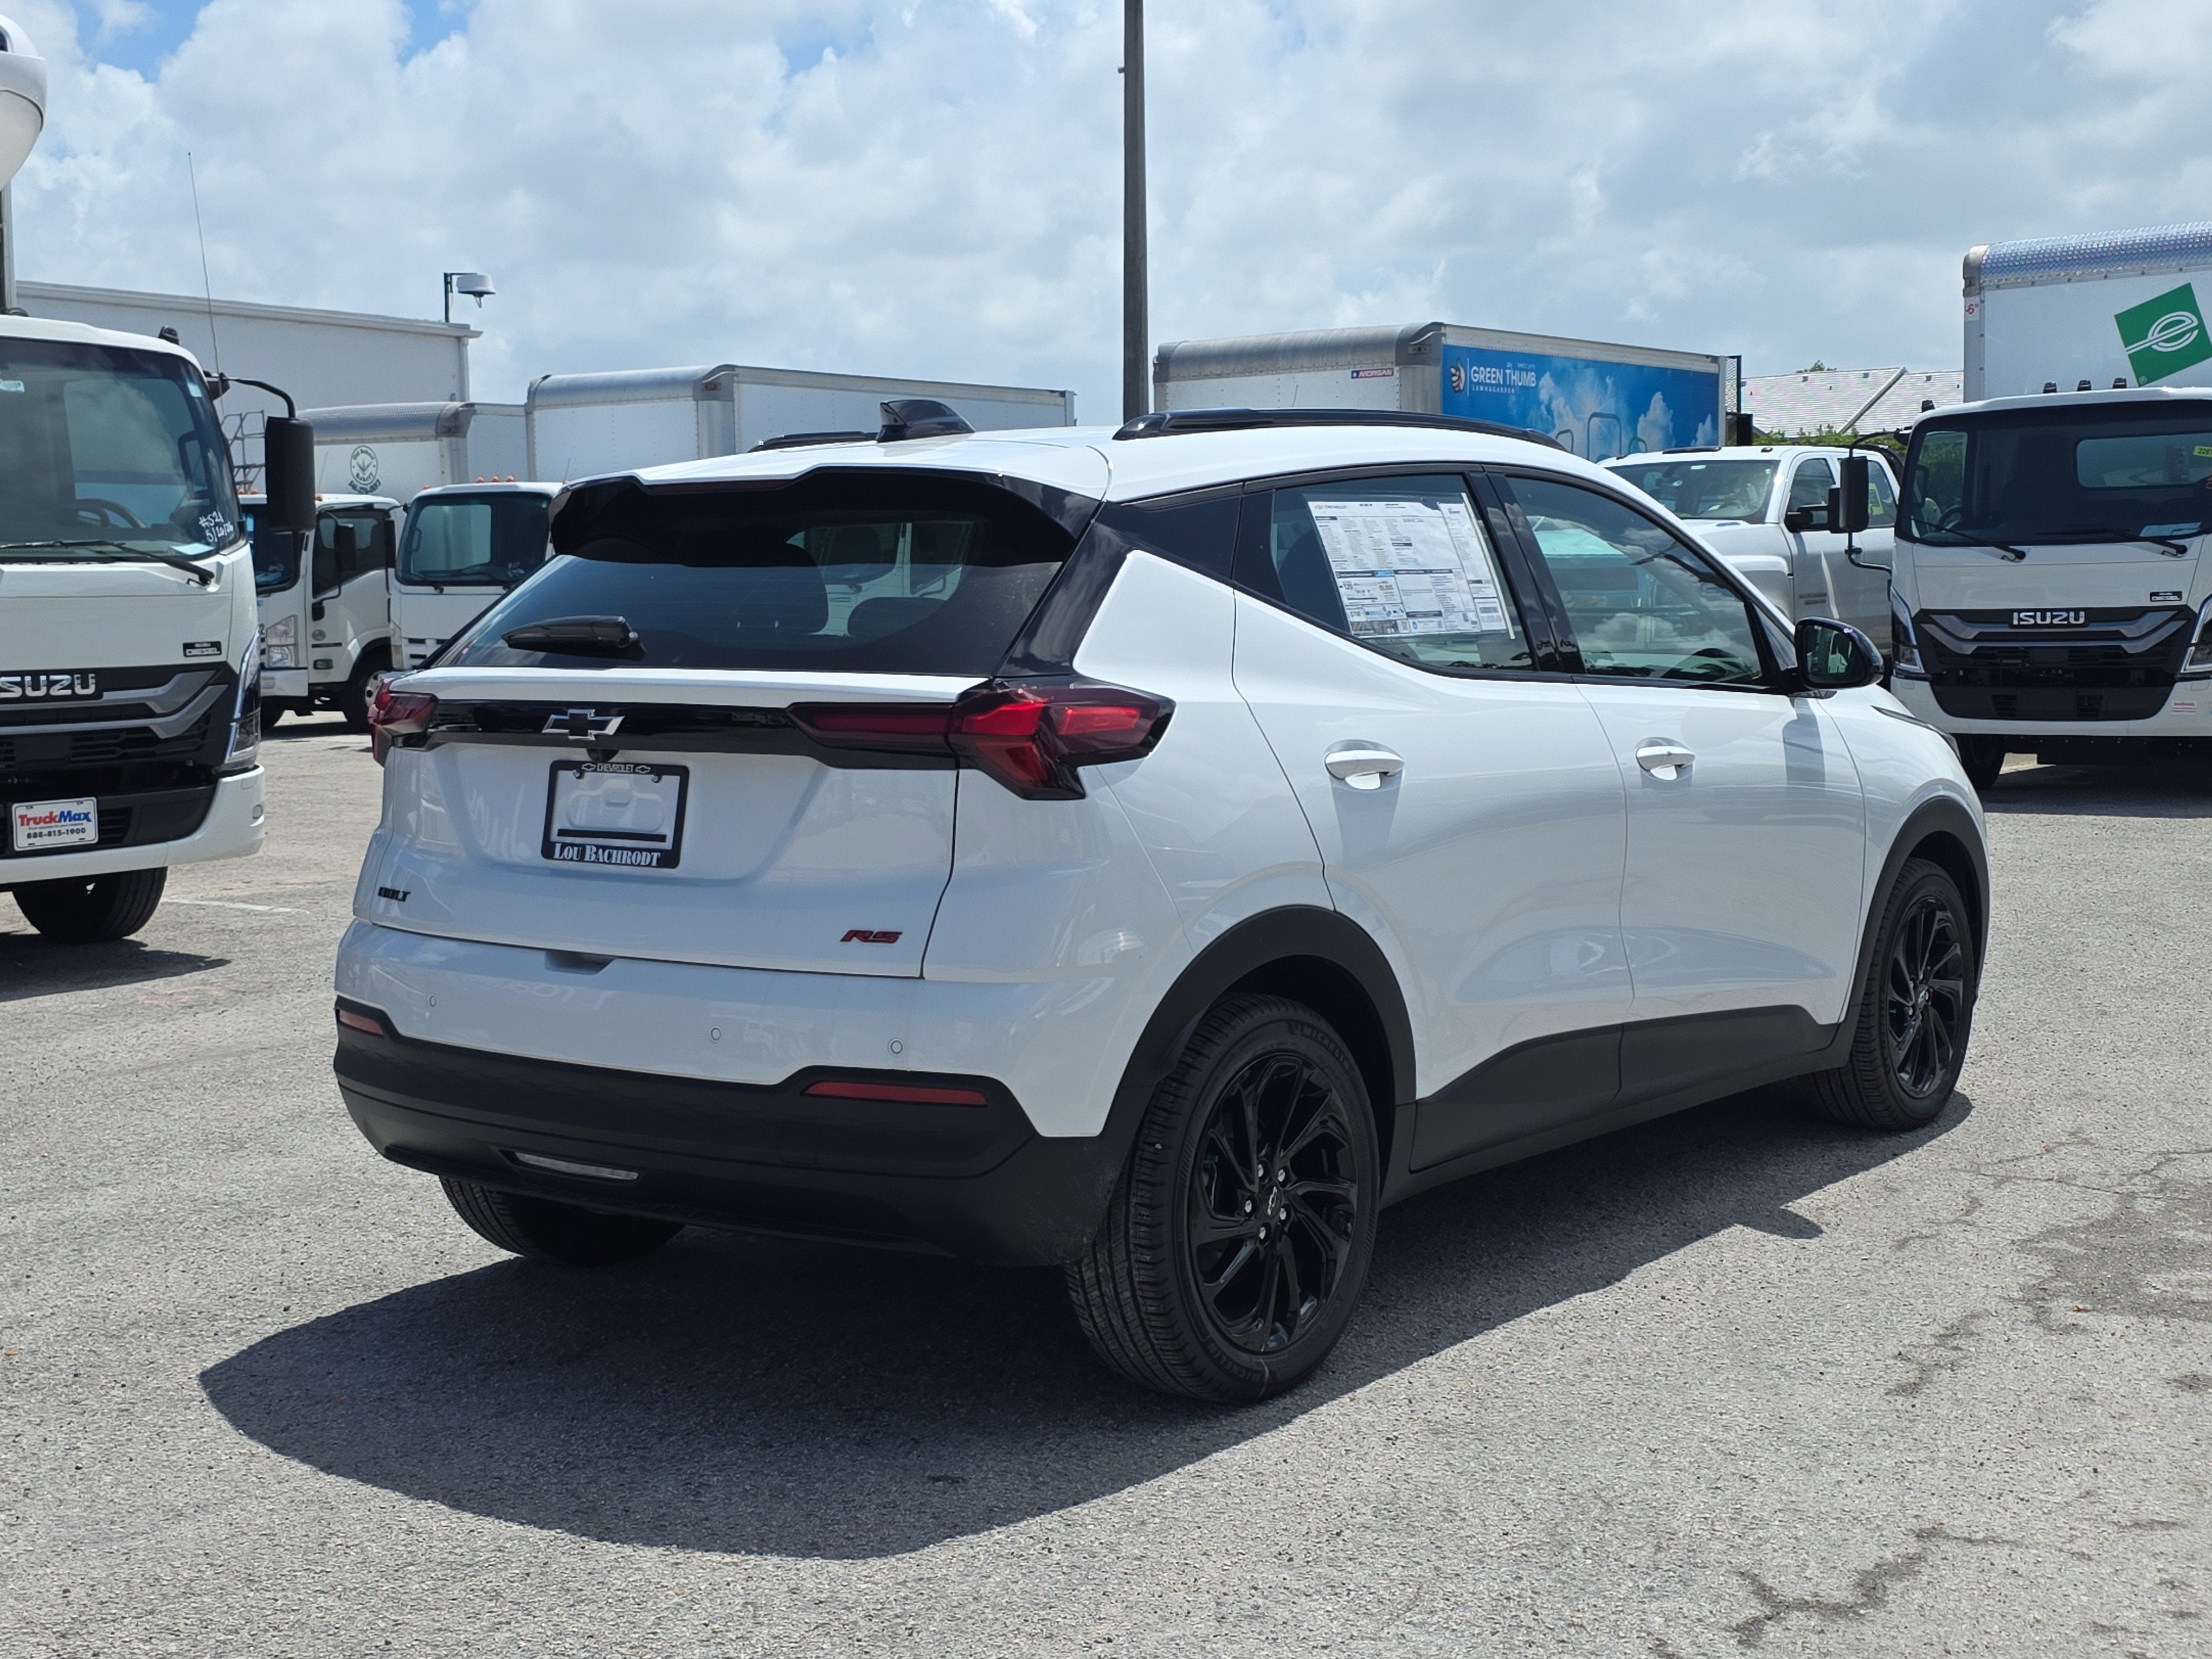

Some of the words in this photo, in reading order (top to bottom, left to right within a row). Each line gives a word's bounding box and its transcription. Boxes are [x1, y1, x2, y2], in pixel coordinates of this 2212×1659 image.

[1471, 366, 1503, 384] GREEN
[1506, 369, 1536, 387] THUMB
[2012, 611, 2085, 625] ISUZU
[0, 674, 96, 698] SUZU
[597, 762, 634, 773] CHEVROLET
[18, 810, 92, 827] TruckMax
[27, 827, 86, 839] 888-815-1900
[378, 886, 411, 902] BOLT
[840, 930, 903, 944] RS
